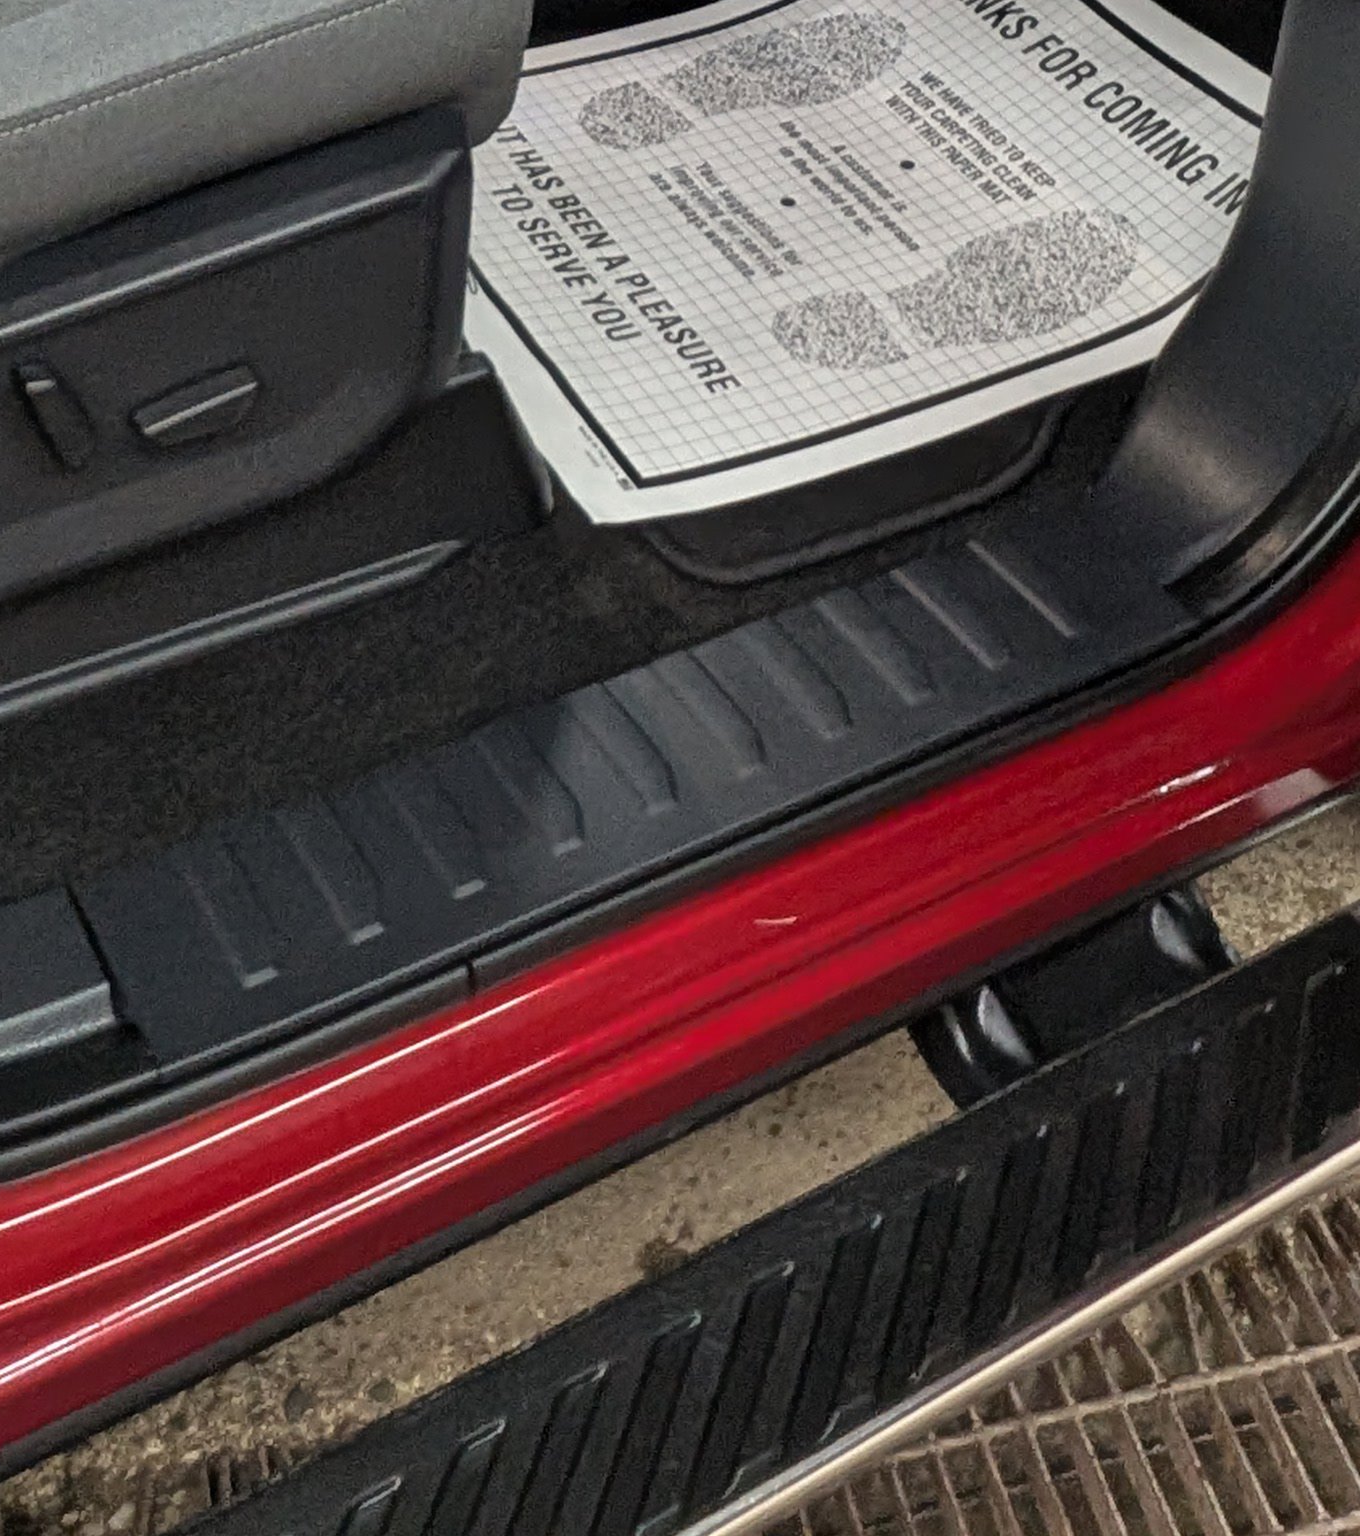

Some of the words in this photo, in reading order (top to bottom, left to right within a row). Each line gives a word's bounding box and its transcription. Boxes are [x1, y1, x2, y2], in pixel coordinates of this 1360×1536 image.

[495, 125, 528, 142] IT
[886, 94, 921, 125] WITH
[915, 119, 946, 148] THIS
[941, 146, 984, 181] PAPER
[978, 181, 1013, 205] MAT
[900, 80, 936, 110] YOUR
[931, 109, 998, 167] CARPETING
[992, 164, 1037, 201] CLEAN
[920, 71, 944, 91] WE
[938, 88, 974, 116] HAVE
[969, 113, 1007, 147] TRIED
[1002, 144, 1026, 162] TO
[1019, 160, 1056, 187] KEEP
[1022, 34, 1097, 90] FOR
[1083, 82, 1219, 186] COMING
[1203, 172, 1249, 216] IN
[509, 149, 565, 190] HAS
[841, 154, 894, 200] customer
[548, 194, 616, 250] BEEN
[667, 194, 708, 229] always
[696, 161, 724, 188] Your
[719, 189, 785, 249] suggestions
[874, 214, 920, 252] person
[492, 183, 534, 211] TO
[517, 217, 597, 288] SERVE
[581, 291, 642, 342] YOU
[597, 253, 631, 273] A
[740, 237, 784, 276] service
[615, 273, 741, 394] PLEASURE
